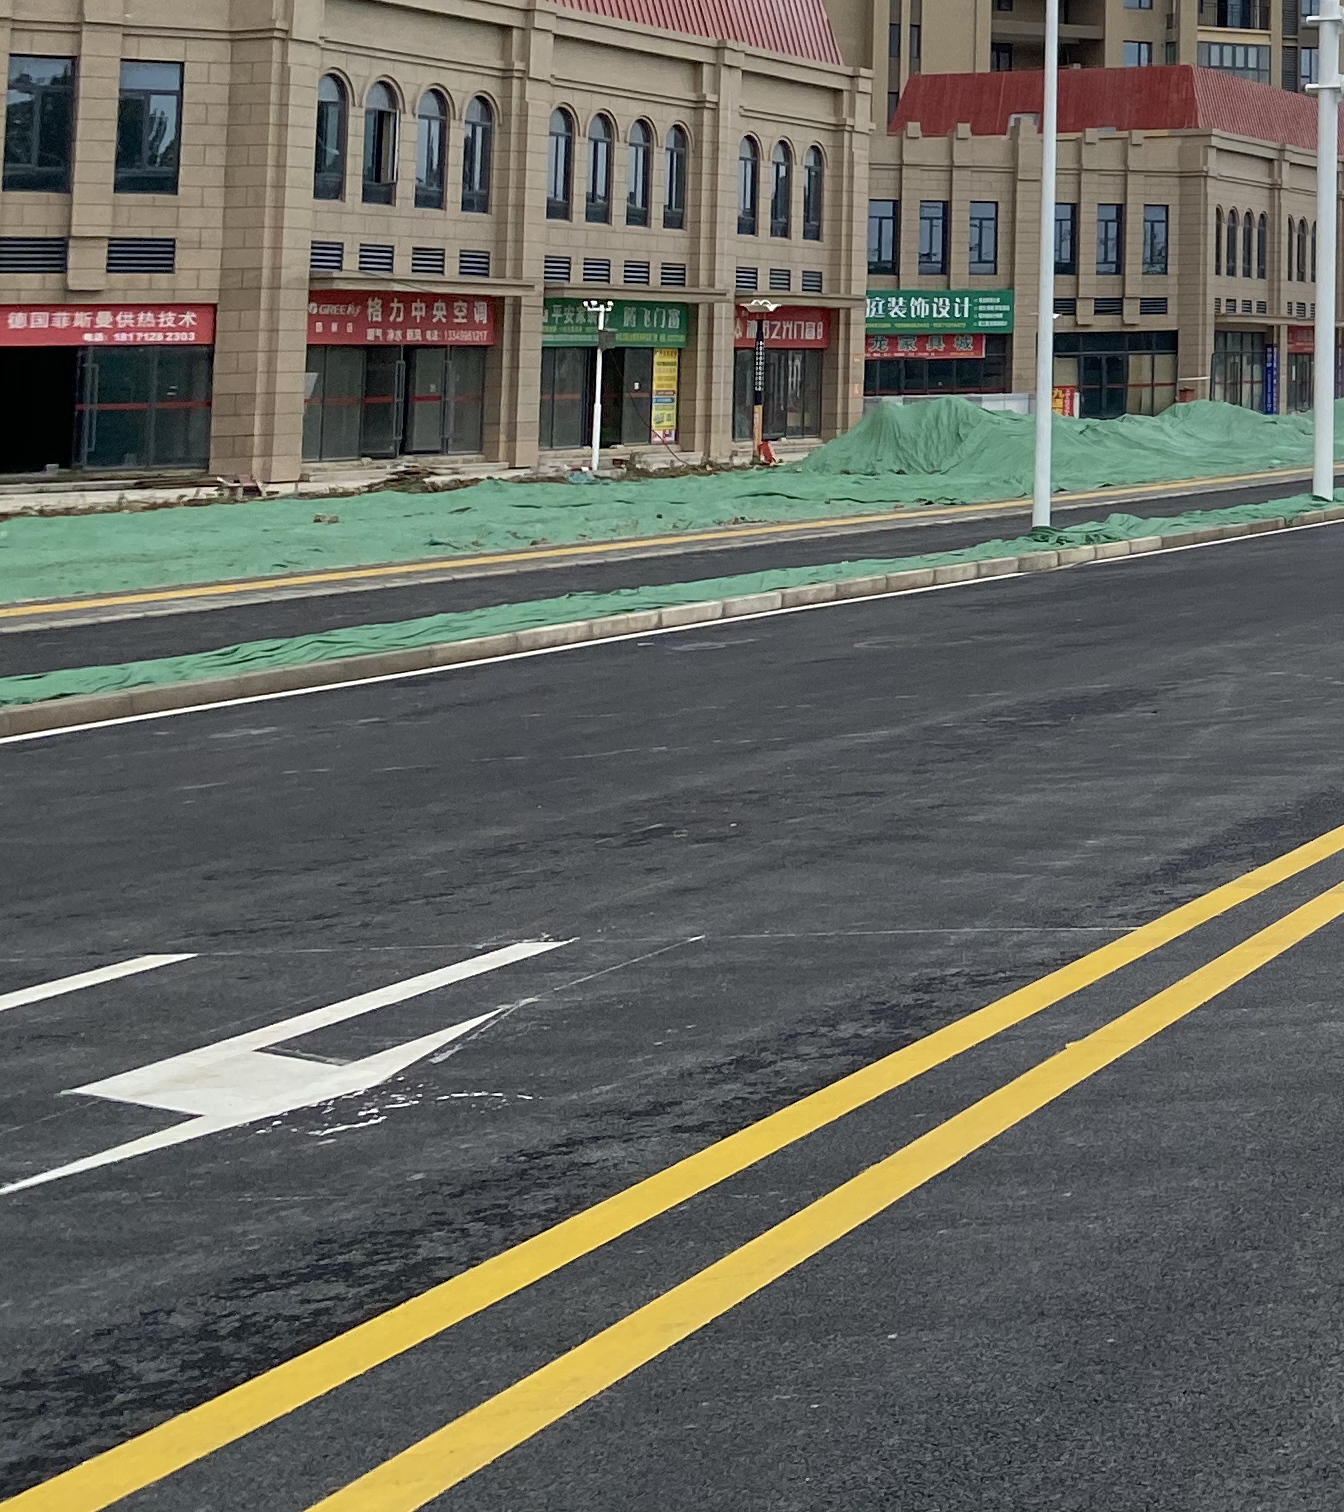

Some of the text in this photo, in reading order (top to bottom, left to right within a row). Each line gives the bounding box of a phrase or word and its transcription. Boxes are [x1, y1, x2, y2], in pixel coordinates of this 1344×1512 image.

[8, 311, 197, 329] 德国菲斯曼供热技术
[367, 297, 488, 324] 格力中央空调
